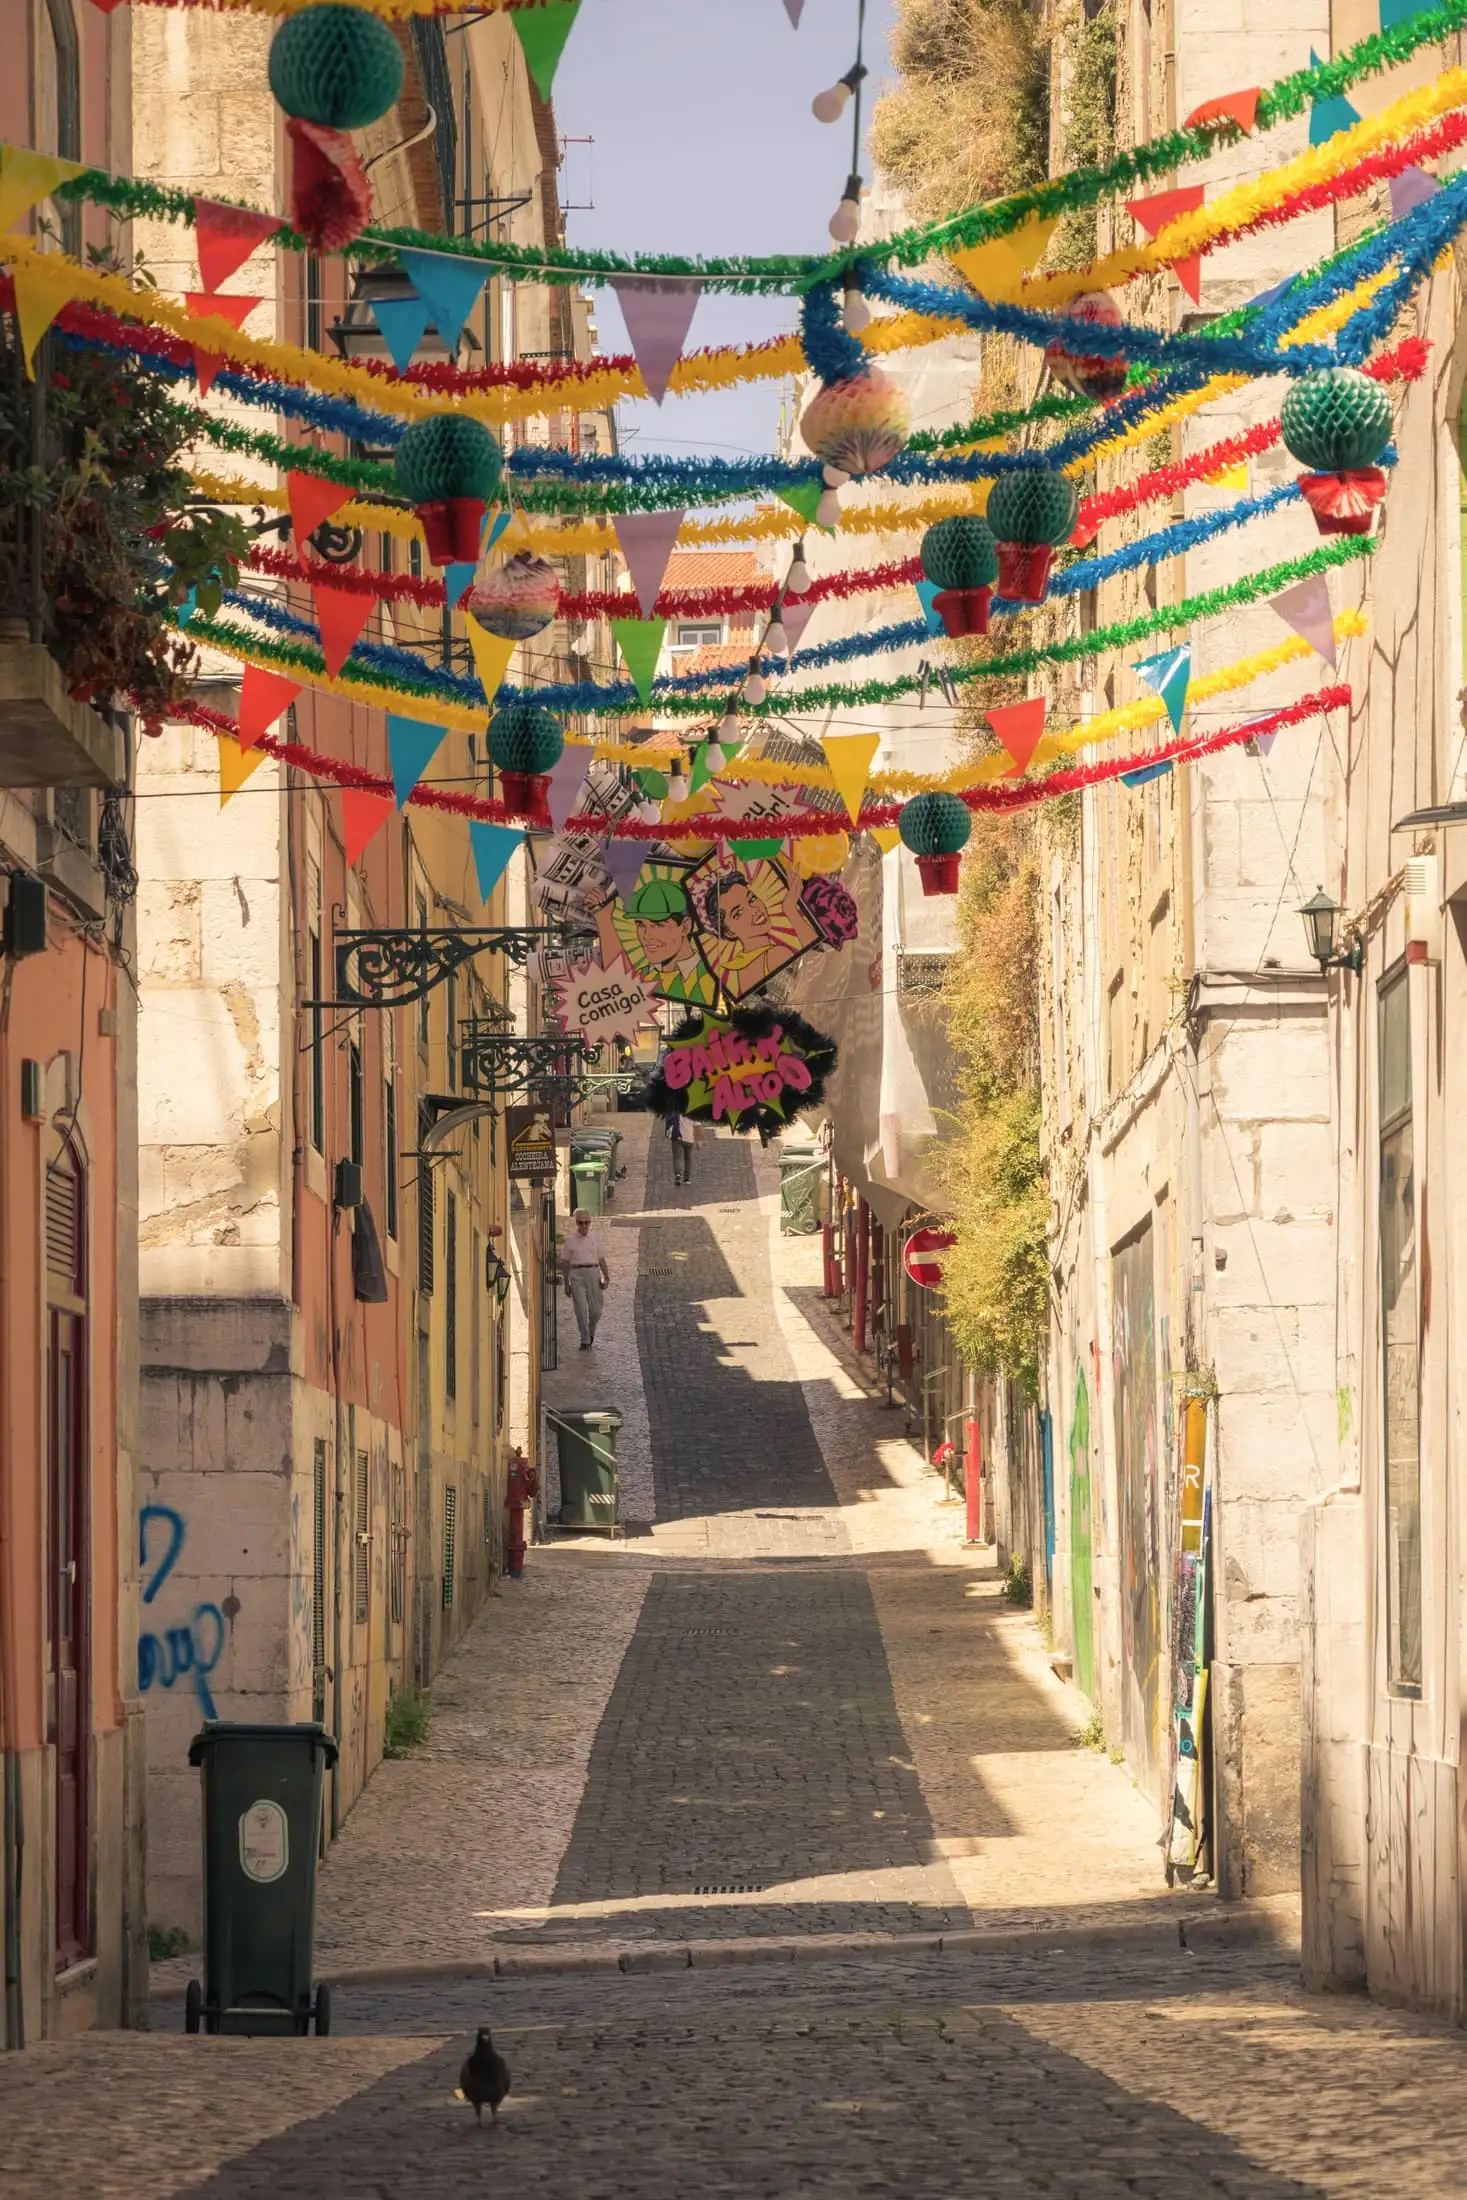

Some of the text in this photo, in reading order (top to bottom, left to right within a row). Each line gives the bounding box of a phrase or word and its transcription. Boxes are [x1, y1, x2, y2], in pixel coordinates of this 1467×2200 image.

[577, 983, 624, 1009] Casa
[579, 985, 646, 1025] comigo!
[711, 1071, 784, 1120] ALTO
[510, 1160, 555, 1171] ALENTEJANA
[515, 1151, 549, 1161] COCHEIRA
